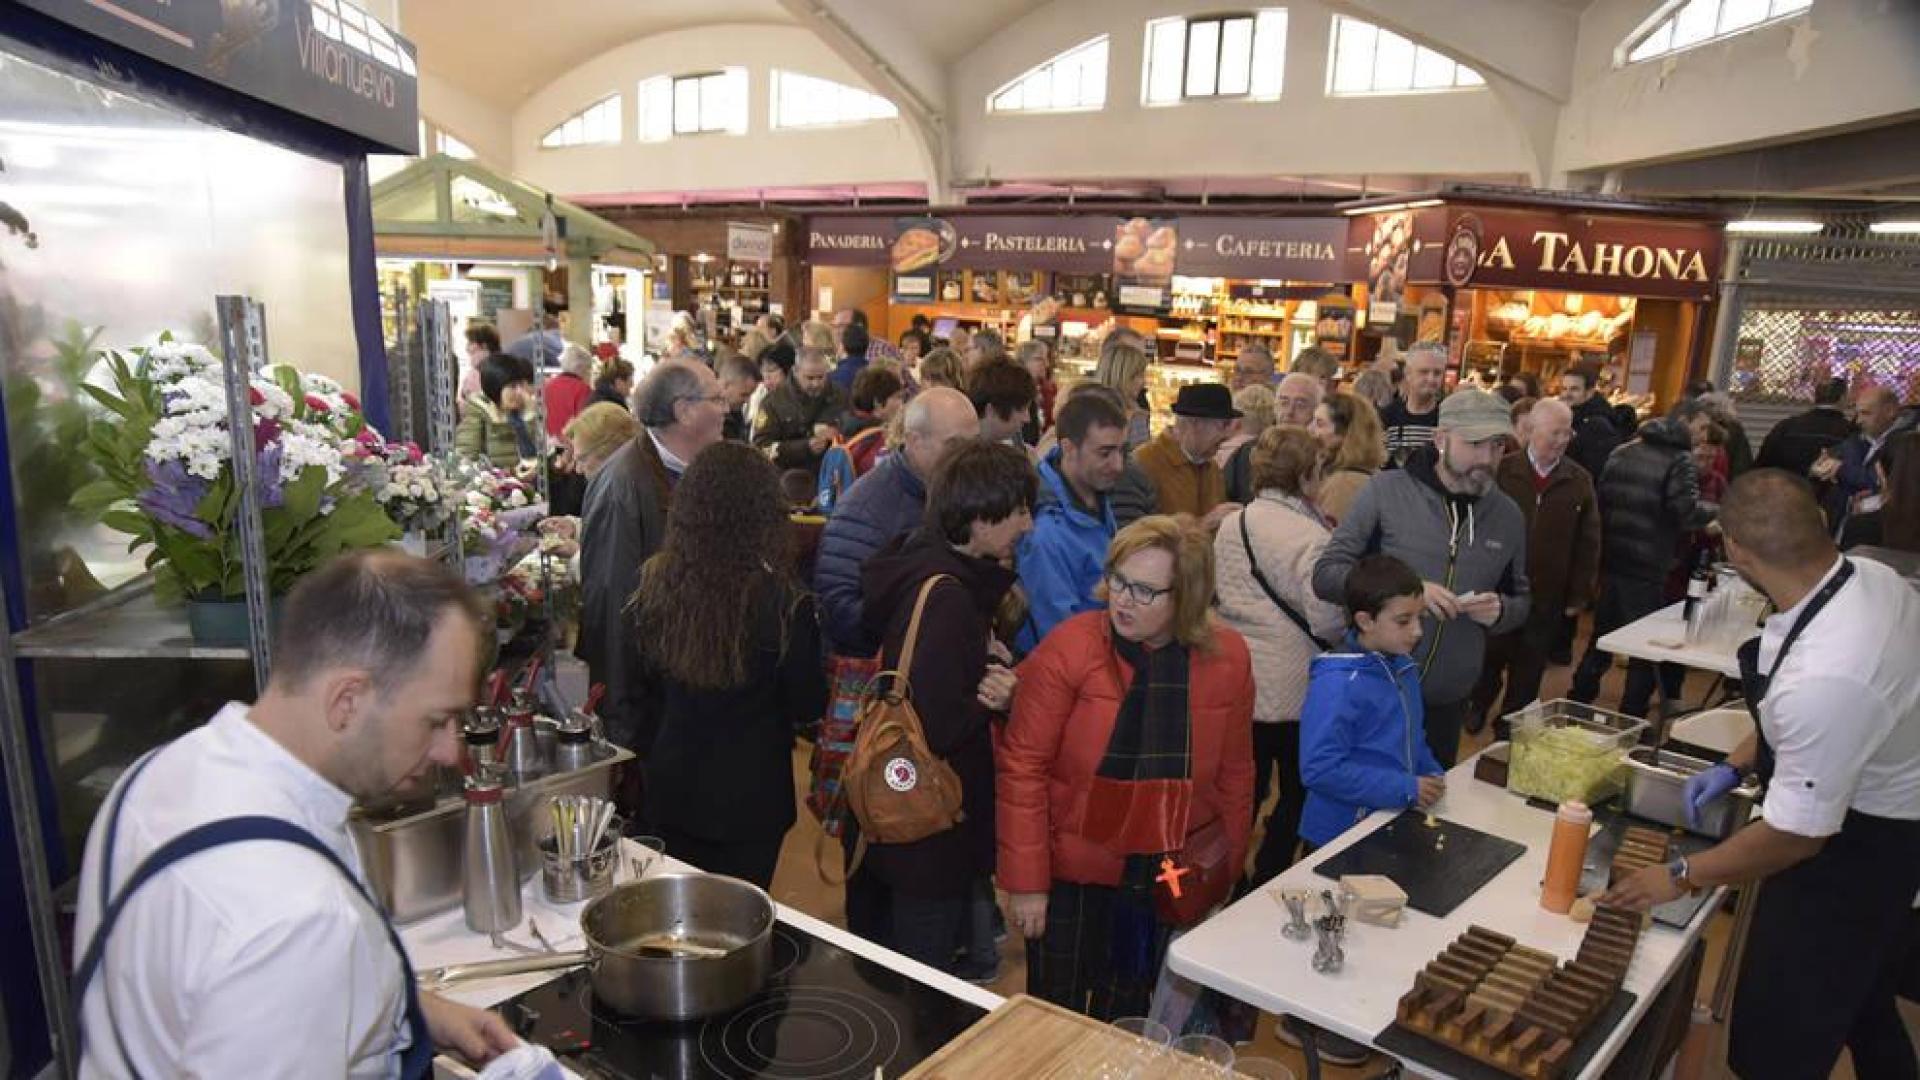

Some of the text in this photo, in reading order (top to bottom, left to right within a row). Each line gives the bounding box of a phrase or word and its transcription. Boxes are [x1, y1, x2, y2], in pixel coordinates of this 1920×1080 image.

[294, 15, 394, 108] Villanueva
[810, 231, 885, 249] PANADERIA
[984, 232, 1087, 253] PASTELERIA
[1216, 234, 1336, 260] CAFETERIA
[1477, 231, 1709, 282] A TAHONA
